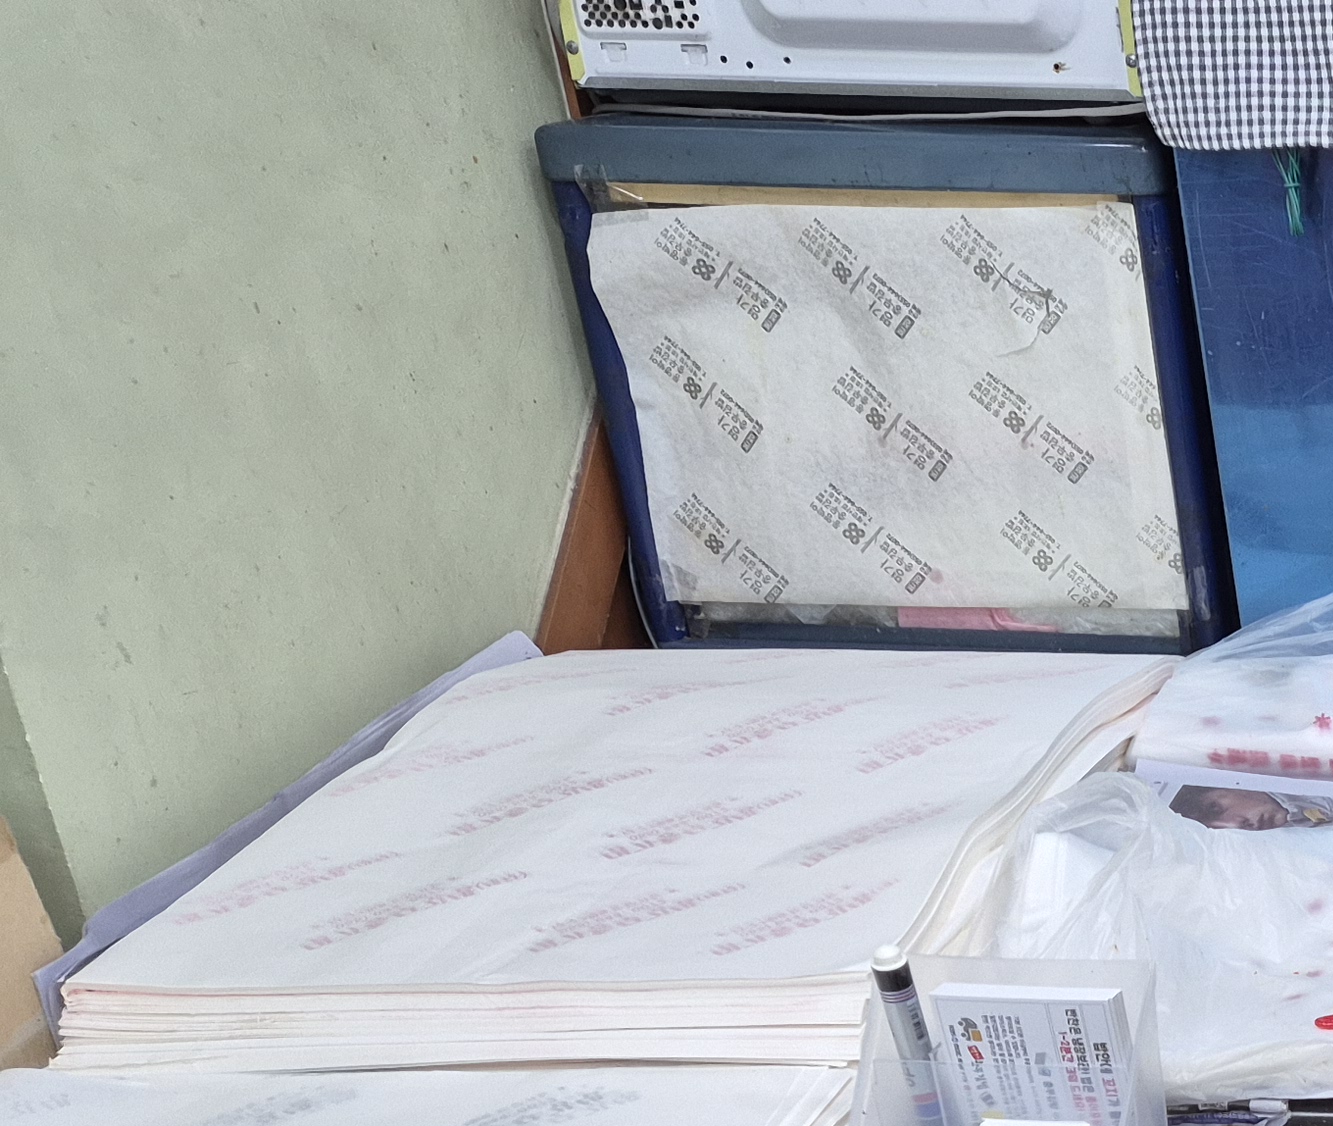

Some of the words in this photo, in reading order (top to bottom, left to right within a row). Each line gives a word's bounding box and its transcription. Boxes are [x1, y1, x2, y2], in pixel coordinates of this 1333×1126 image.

[731, 293, 764, 319] 명가
[866, 299, 896, 327] 명가
[1009, 294, 1041, 322] 명가
[715, 414, 742, 442] 명가
[900, 443, 929, 471] 명가
[1038, 446, 1069, 473] 명가
[736, 570, 767, 596] 명가
[877, 557, 907, 583] 명가
